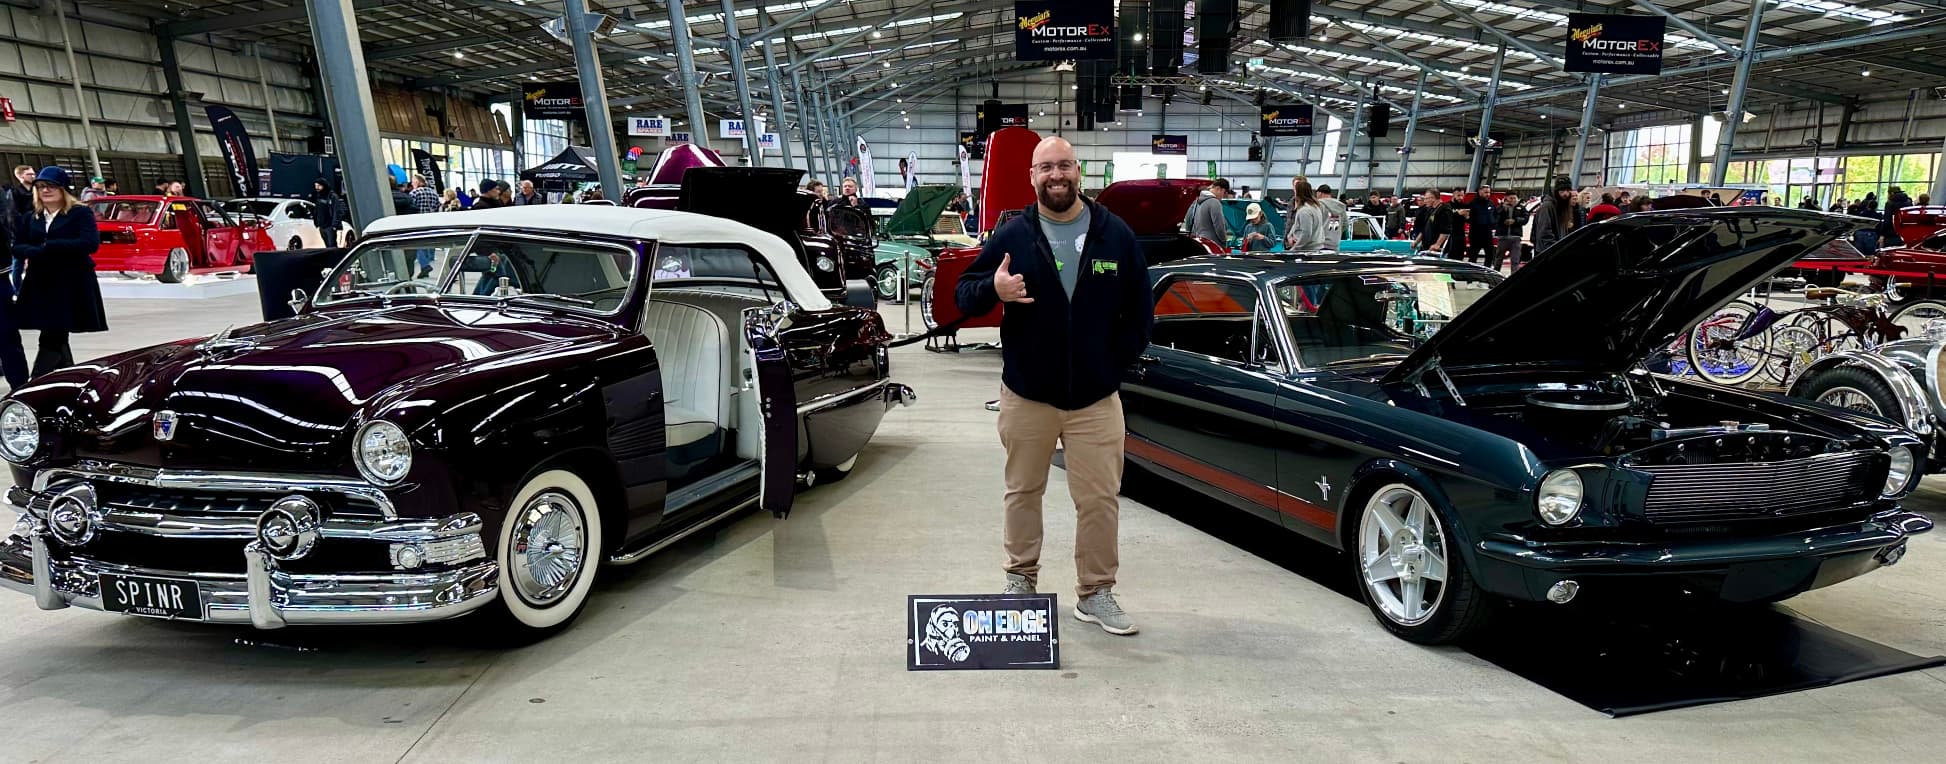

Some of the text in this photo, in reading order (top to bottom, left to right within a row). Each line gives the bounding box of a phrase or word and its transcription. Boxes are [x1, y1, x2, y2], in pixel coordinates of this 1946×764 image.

[636, 119, 663, 129] RARE
[115, 580, 185, 610] SPINR
[135, 606, 168, 615] VICTORIA
[963, 609, 1048, 635] ON EDGE
[969, 635, 997, 643] PAINT
